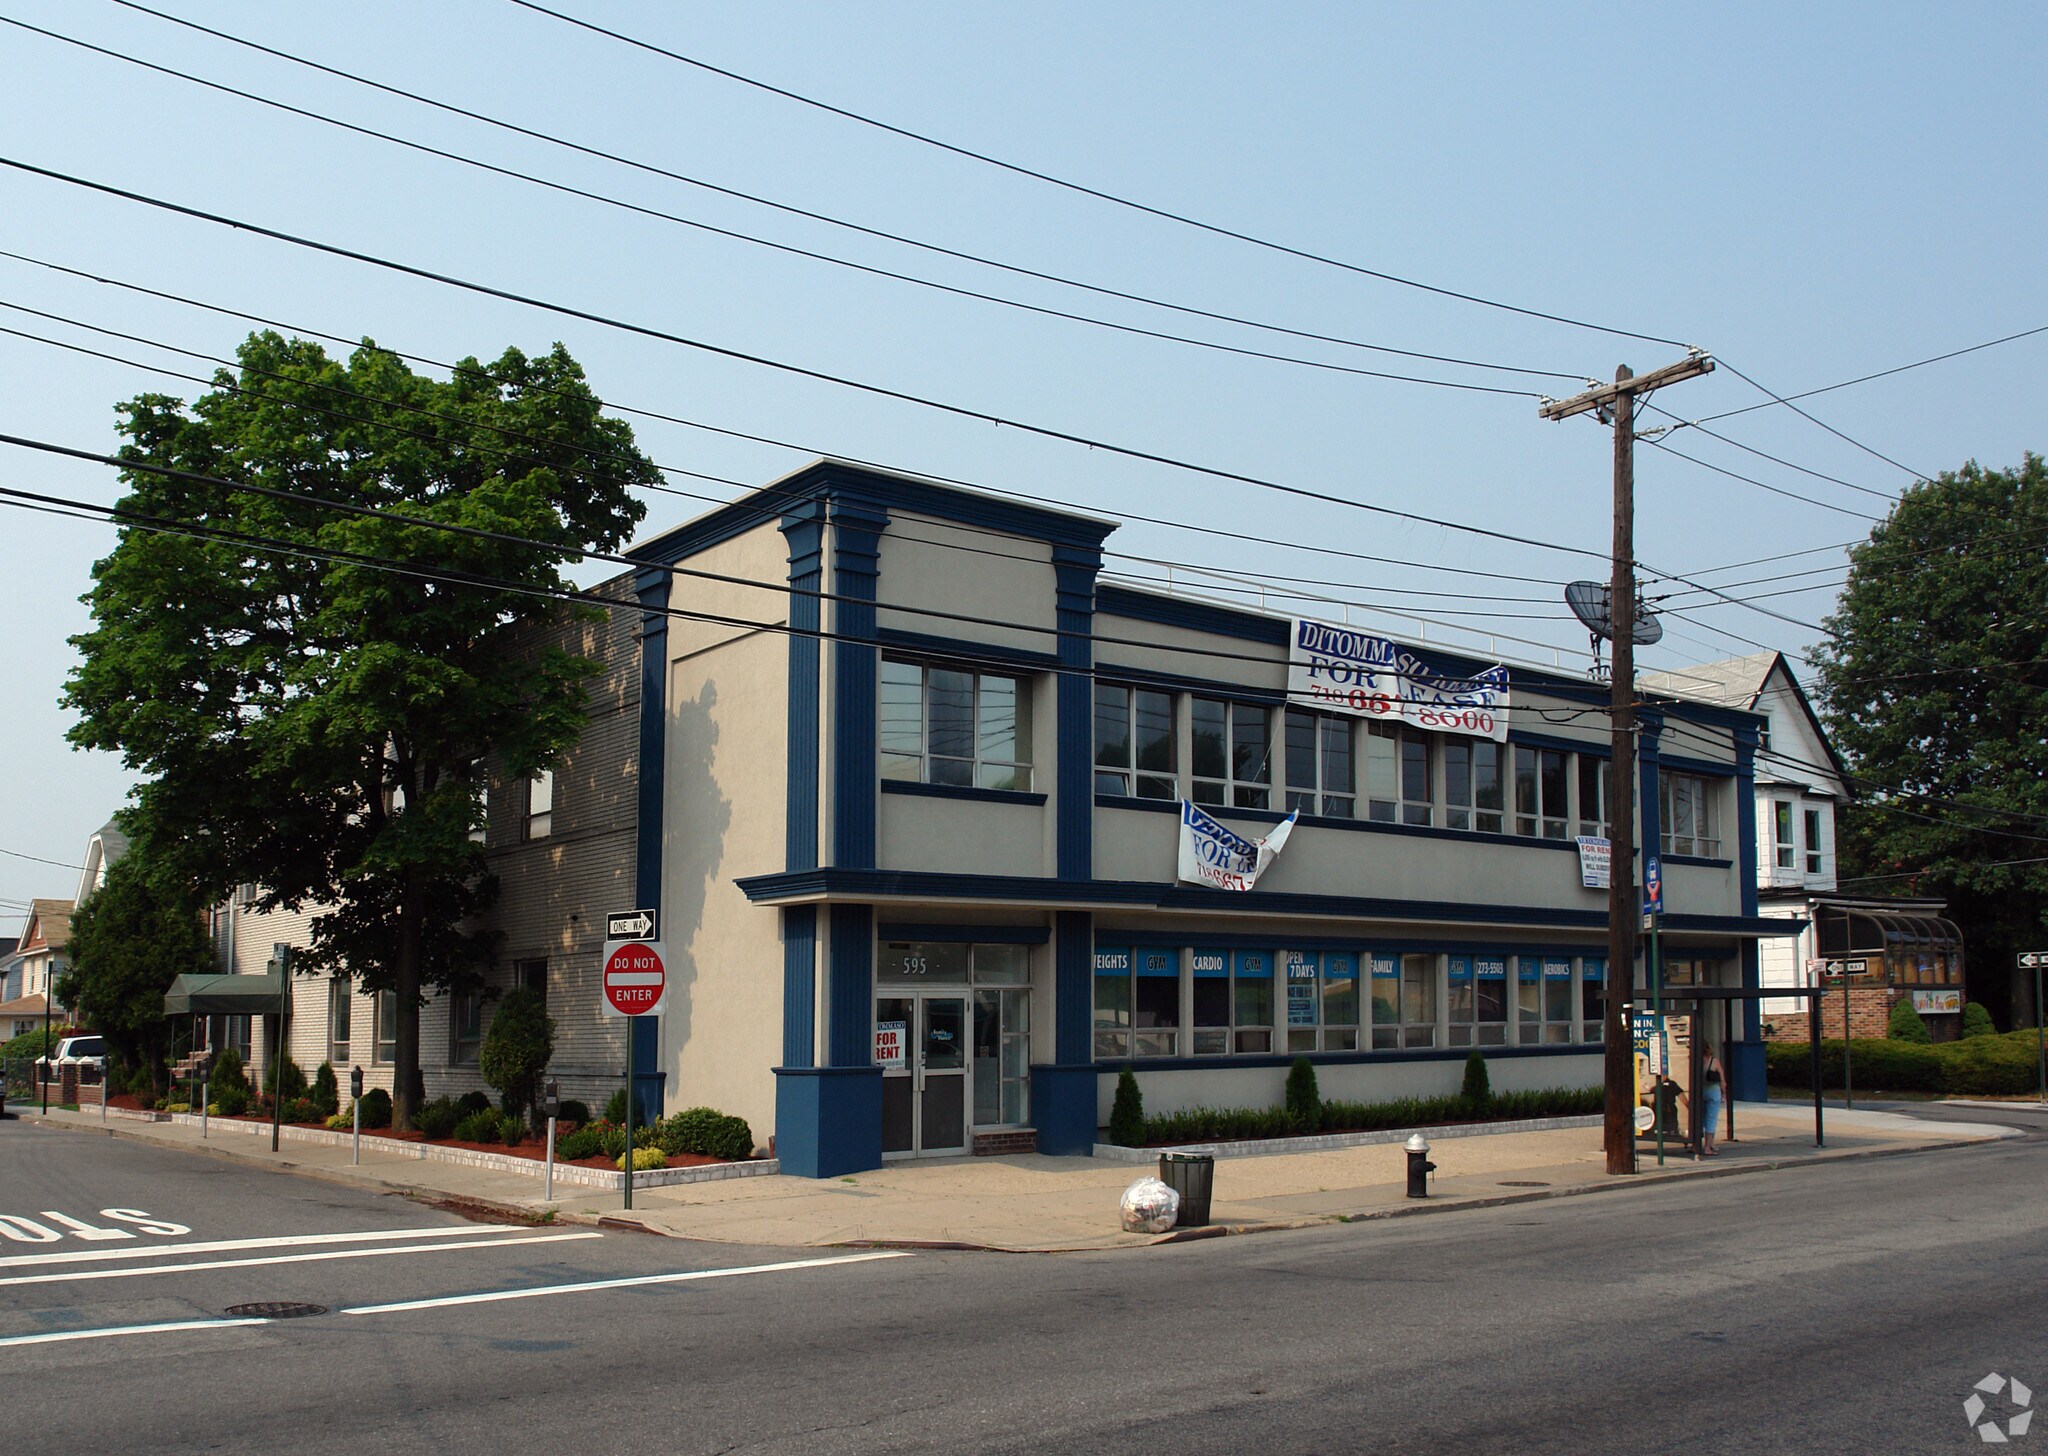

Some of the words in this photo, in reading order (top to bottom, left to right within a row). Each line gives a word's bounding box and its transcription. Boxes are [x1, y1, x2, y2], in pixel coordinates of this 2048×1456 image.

[1307, 654, 1378, 689] FOR
[1310, 684, 1344, 703] 718
[1193, 832, 1231, 869] FOR
[1581, 845, 1596, 853] FOR
[1597, 846, 1612, 854] REN
[613, 921, 627, 932] ONE
[633, 920, 647, 930] WAY
[614, 958, 629, 969] DO
[633, 957, 655, 969] NOT
[903, 956, 927, 975] 595
[1147, 955, 1167, 971] GYM
[1193, 956, 1223, 971] CARDIO
[1244, 956, 1262, 972] GYM
[1544, 963, 1570, 976] AEROBICS
[1849, 962, 1863, 971] WAY
[616, 989, 652, 1002] ENTER
[876, 1032, 897, 1045] FOR
[0, 1208, 191, 1243] STO
